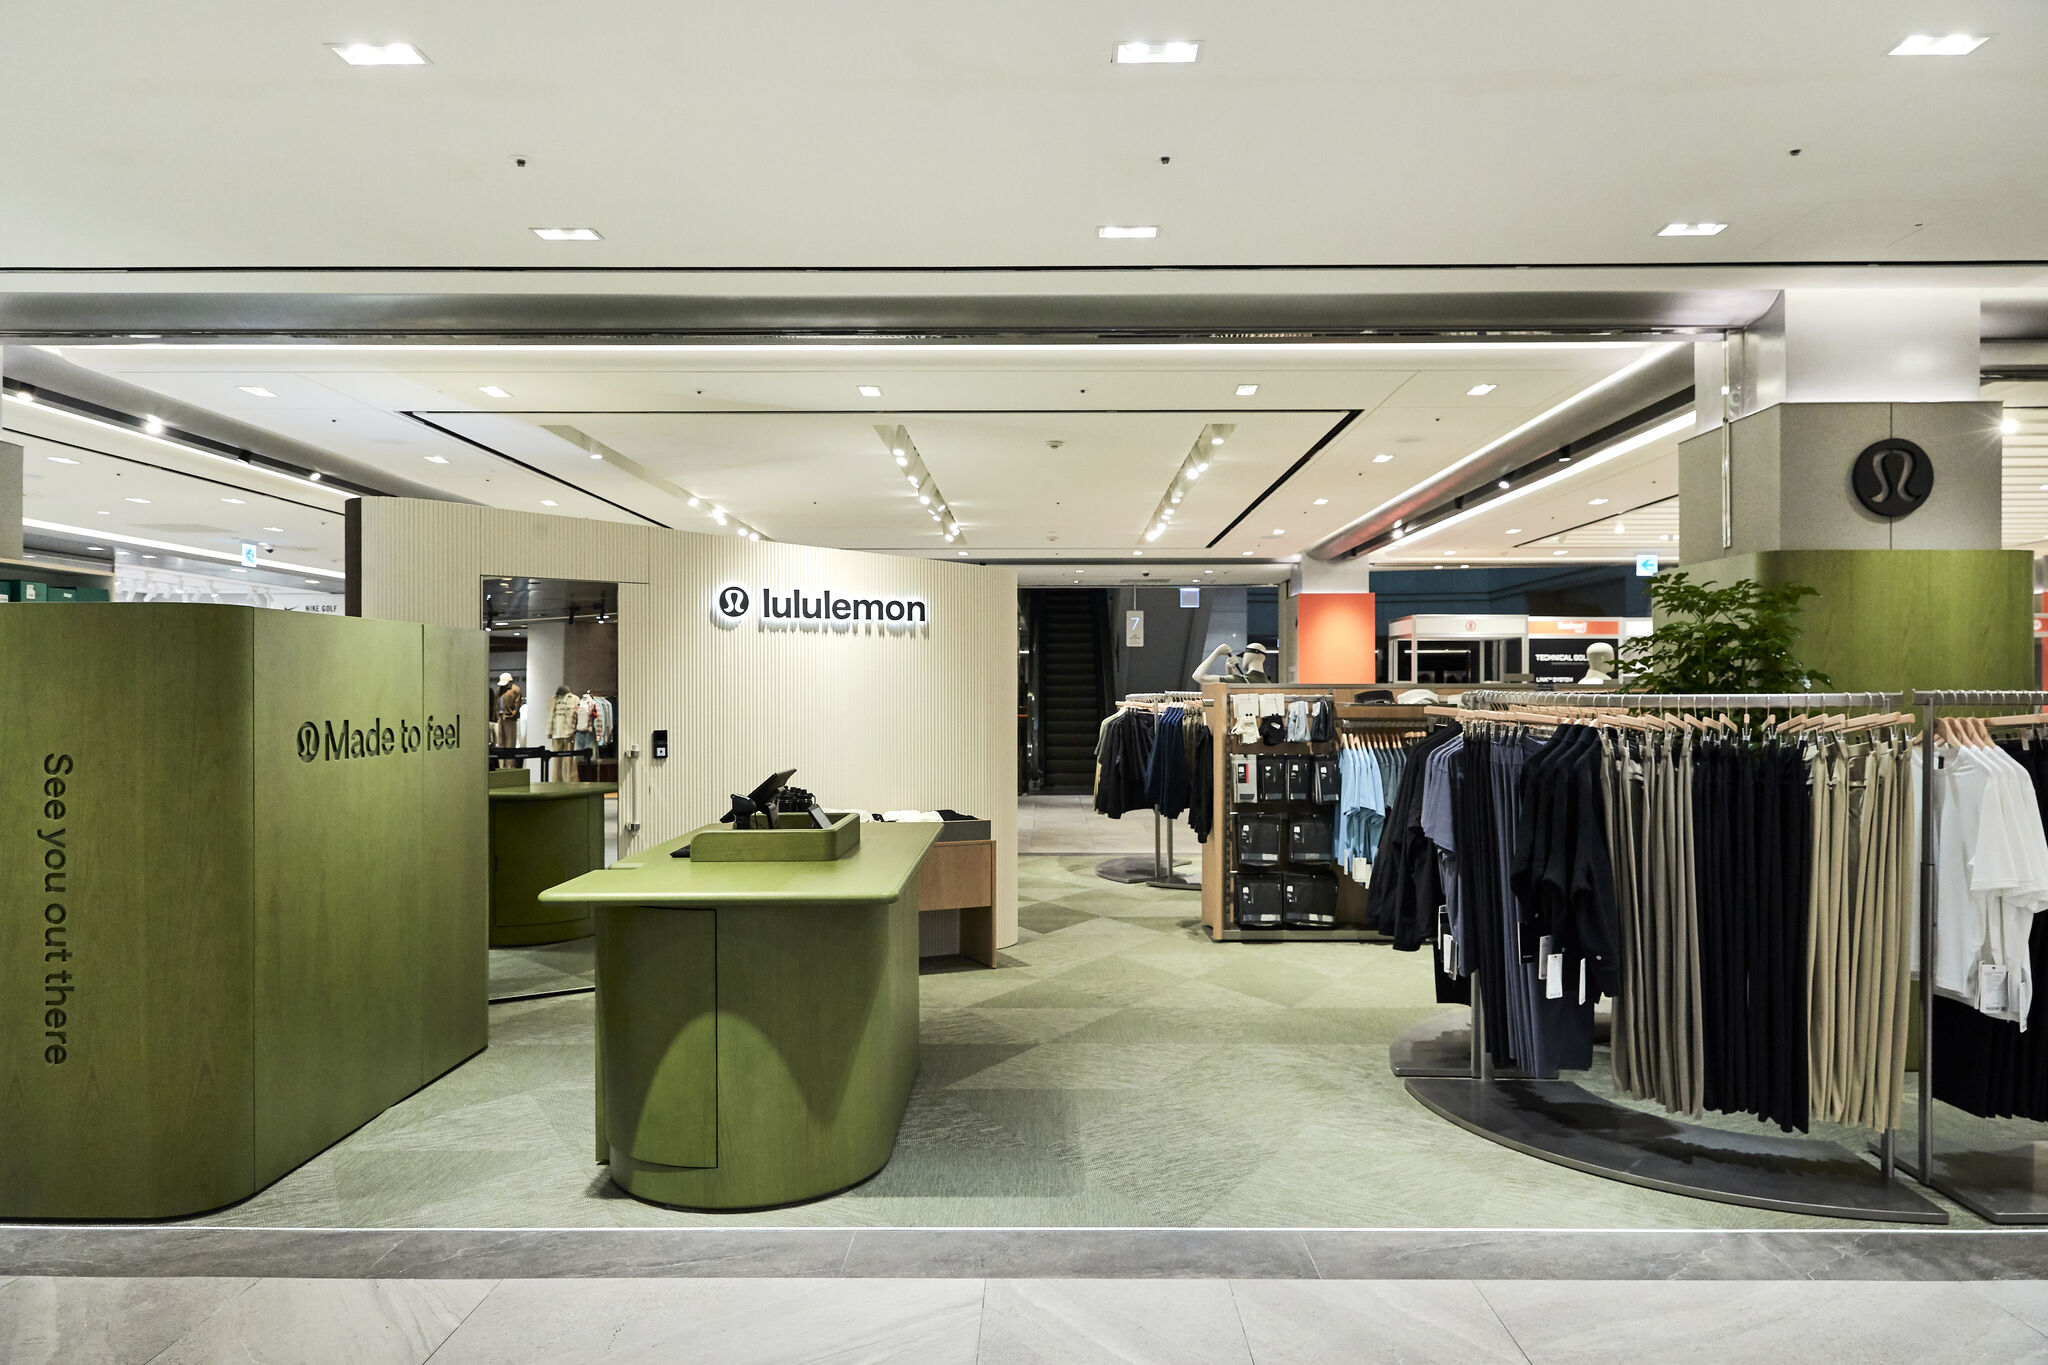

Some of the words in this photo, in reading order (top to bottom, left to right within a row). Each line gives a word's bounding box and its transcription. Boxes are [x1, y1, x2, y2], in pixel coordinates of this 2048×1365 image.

[763, 588, 926, 622] lululemon
[1130, 617, 1140, 631] 7
[324, 717, 395, 761] Made
[400, 719, 421, 753] to
[427, 714, 460, 751] feel
[43, 753, 74, 820] See
[37, 828, 66, 892] you
[44, 903, 73, 962] out
[44, 970, 75, 1064] there
